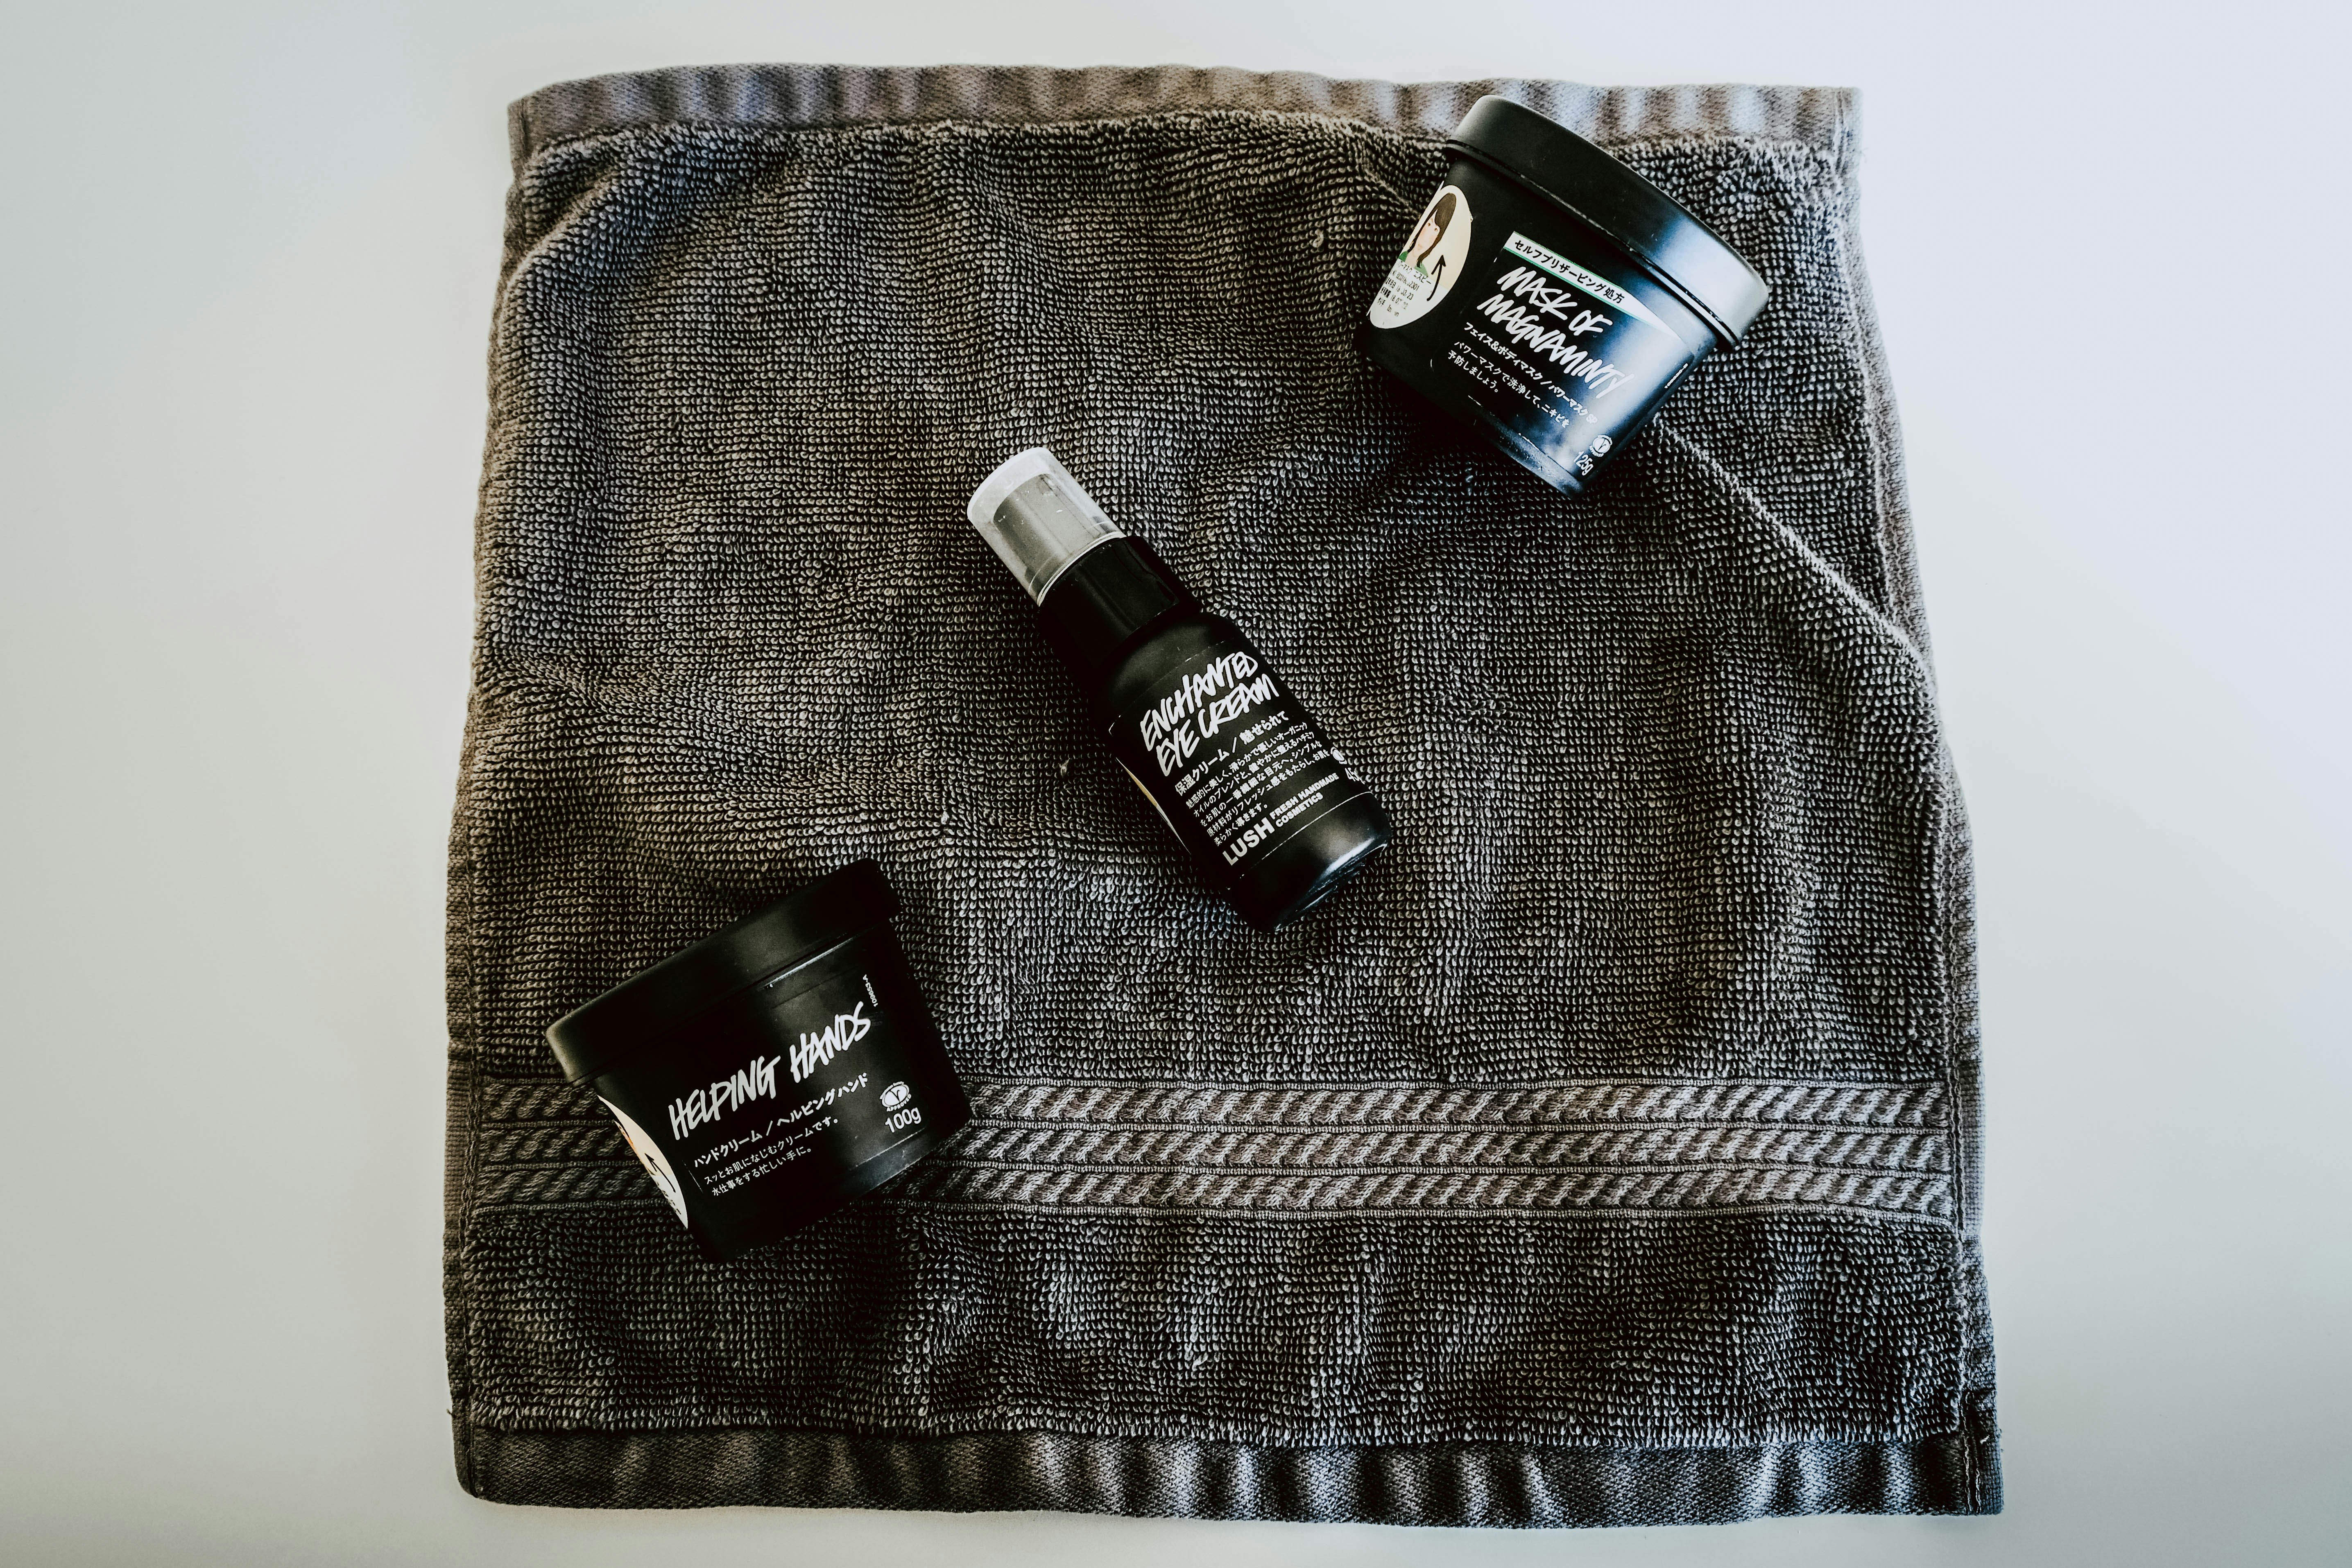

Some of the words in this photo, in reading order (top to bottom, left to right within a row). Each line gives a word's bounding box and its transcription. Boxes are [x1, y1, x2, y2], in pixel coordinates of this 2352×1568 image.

[1514, 240, 1625, 303] セルフプリザービング処方
[1497, 267, 1578, 320] MASK
[1569, 310, 1613, 335] OF
[1448, 350, 1498, 393] 予防しましょう。
[1477, 294, 1634, 398] MAGNAMINTY
[1573, 451, 1594, 476] 125g
[1140, 652, 1258, 751] ENCHANTED
[1156, 719, 1200, 776] EYE
[1198, 673, 1279, 738] CREAM
[1270, 796, 1299, 819] FRESH
[1297, 773, 1339, 800] HANDMADE
[1276, 792, 1323, 827] COSMETICS
[1222, 817, 1275, 866] LUSH
[668, 1055, 781, 1140] HELPING
[790, 1001, 871, 1083] HANDS
[885, 1107, 921, 1133] 100g
[704, 1116, 838, 1185] スッとお肌になじむクリームです。
[712, 1146, 811, 1196] 水仕事をする忙しい手に。
